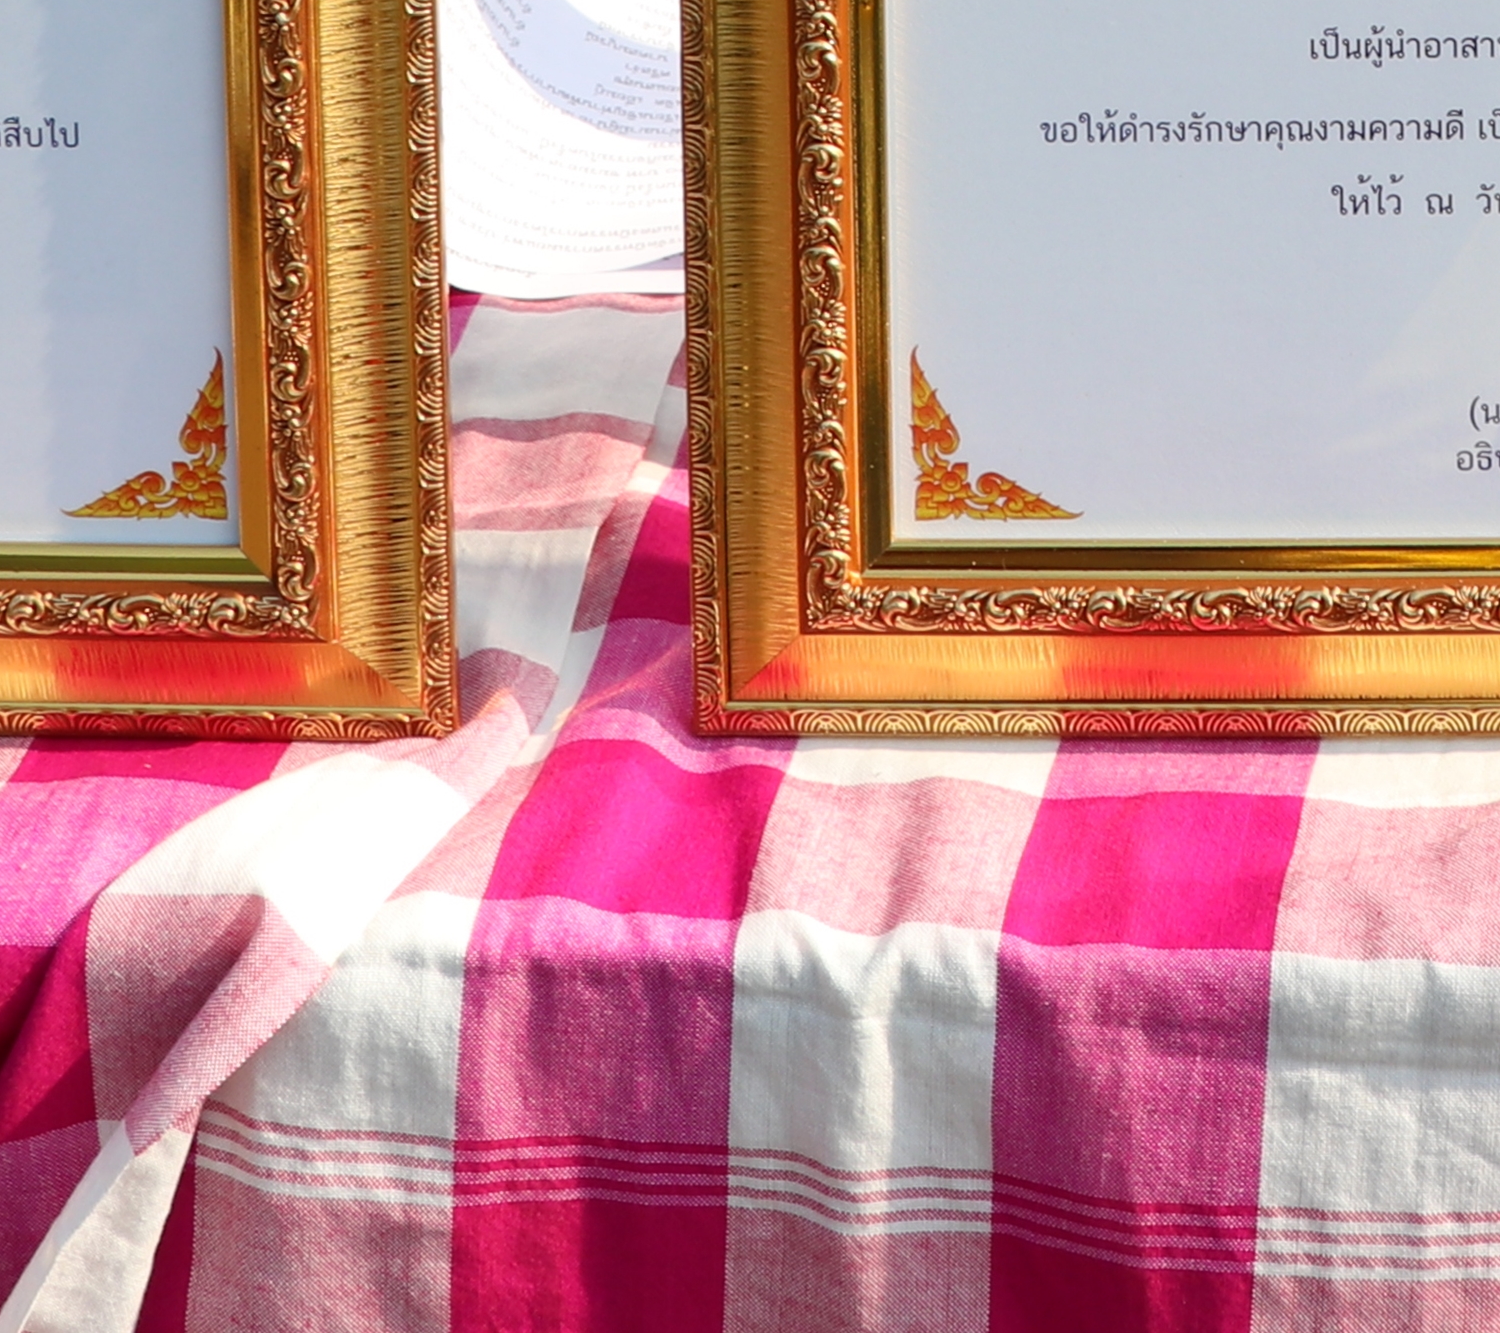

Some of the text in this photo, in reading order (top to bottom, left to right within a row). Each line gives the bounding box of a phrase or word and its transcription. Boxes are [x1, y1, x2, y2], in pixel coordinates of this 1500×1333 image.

[1330, 173, 1405, 216] ให้ไว้
[1424, 192, 1454, 216] ณ
